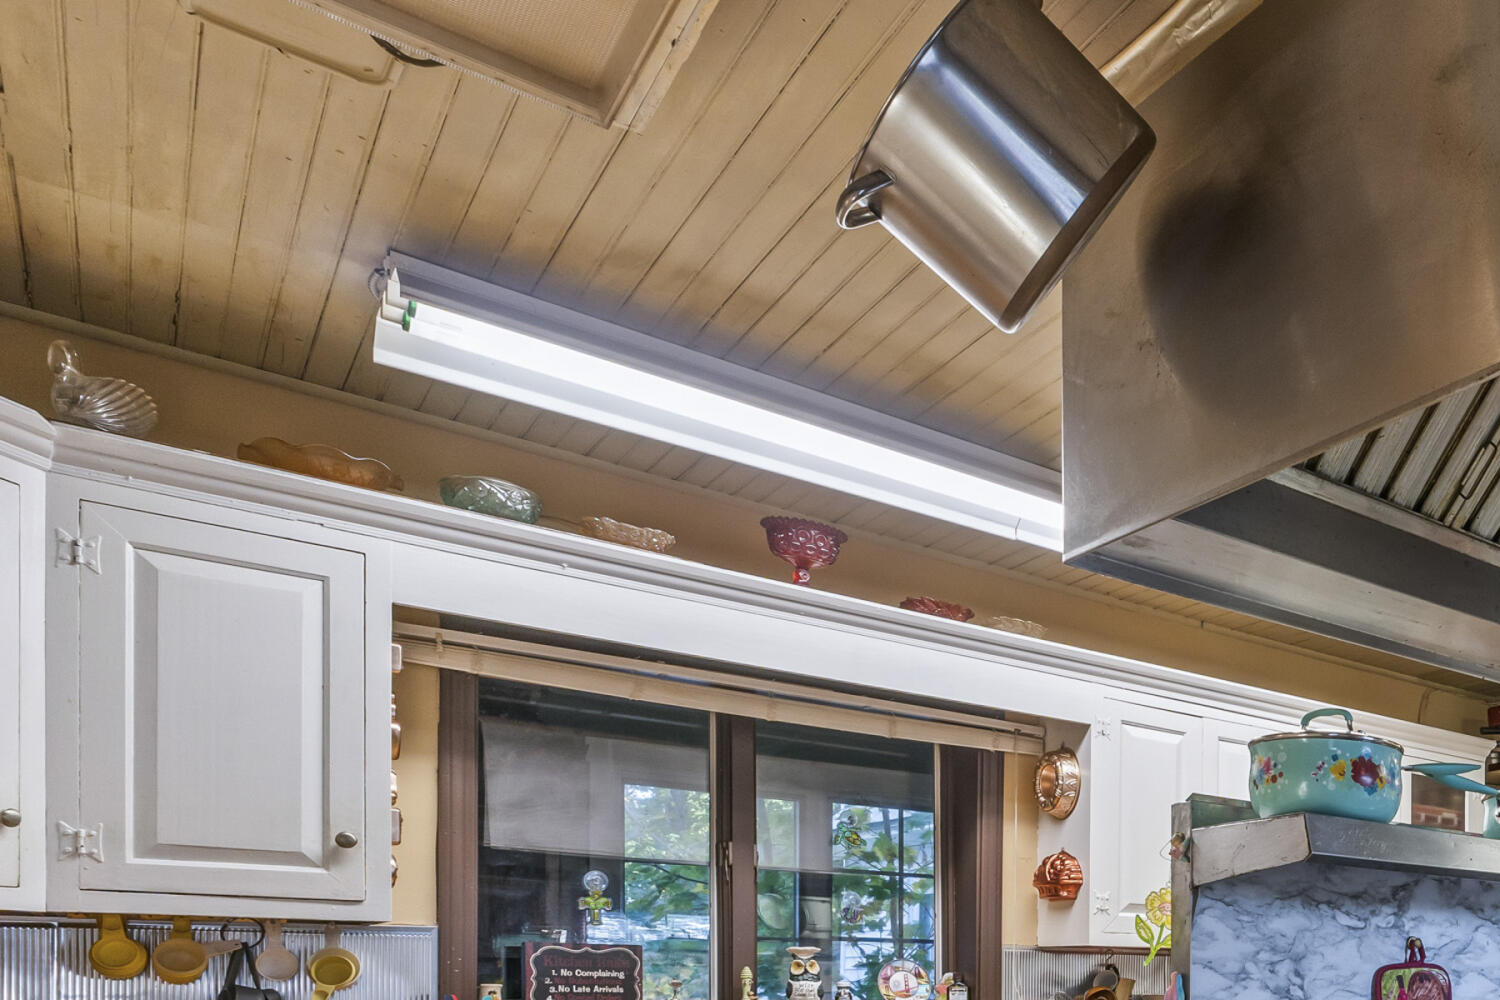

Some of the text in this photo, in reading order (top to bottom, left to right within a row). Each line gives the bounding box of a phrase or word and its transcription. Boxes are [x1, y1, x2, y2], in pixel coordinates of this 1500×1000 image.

[560, 969, 573, 977] No
[575, 969, 625, 979] Complaining
[558, 985, 570, 993] No
[573, 985, 591, 993] Late
[593, 985, 624, 993] Arrivals
